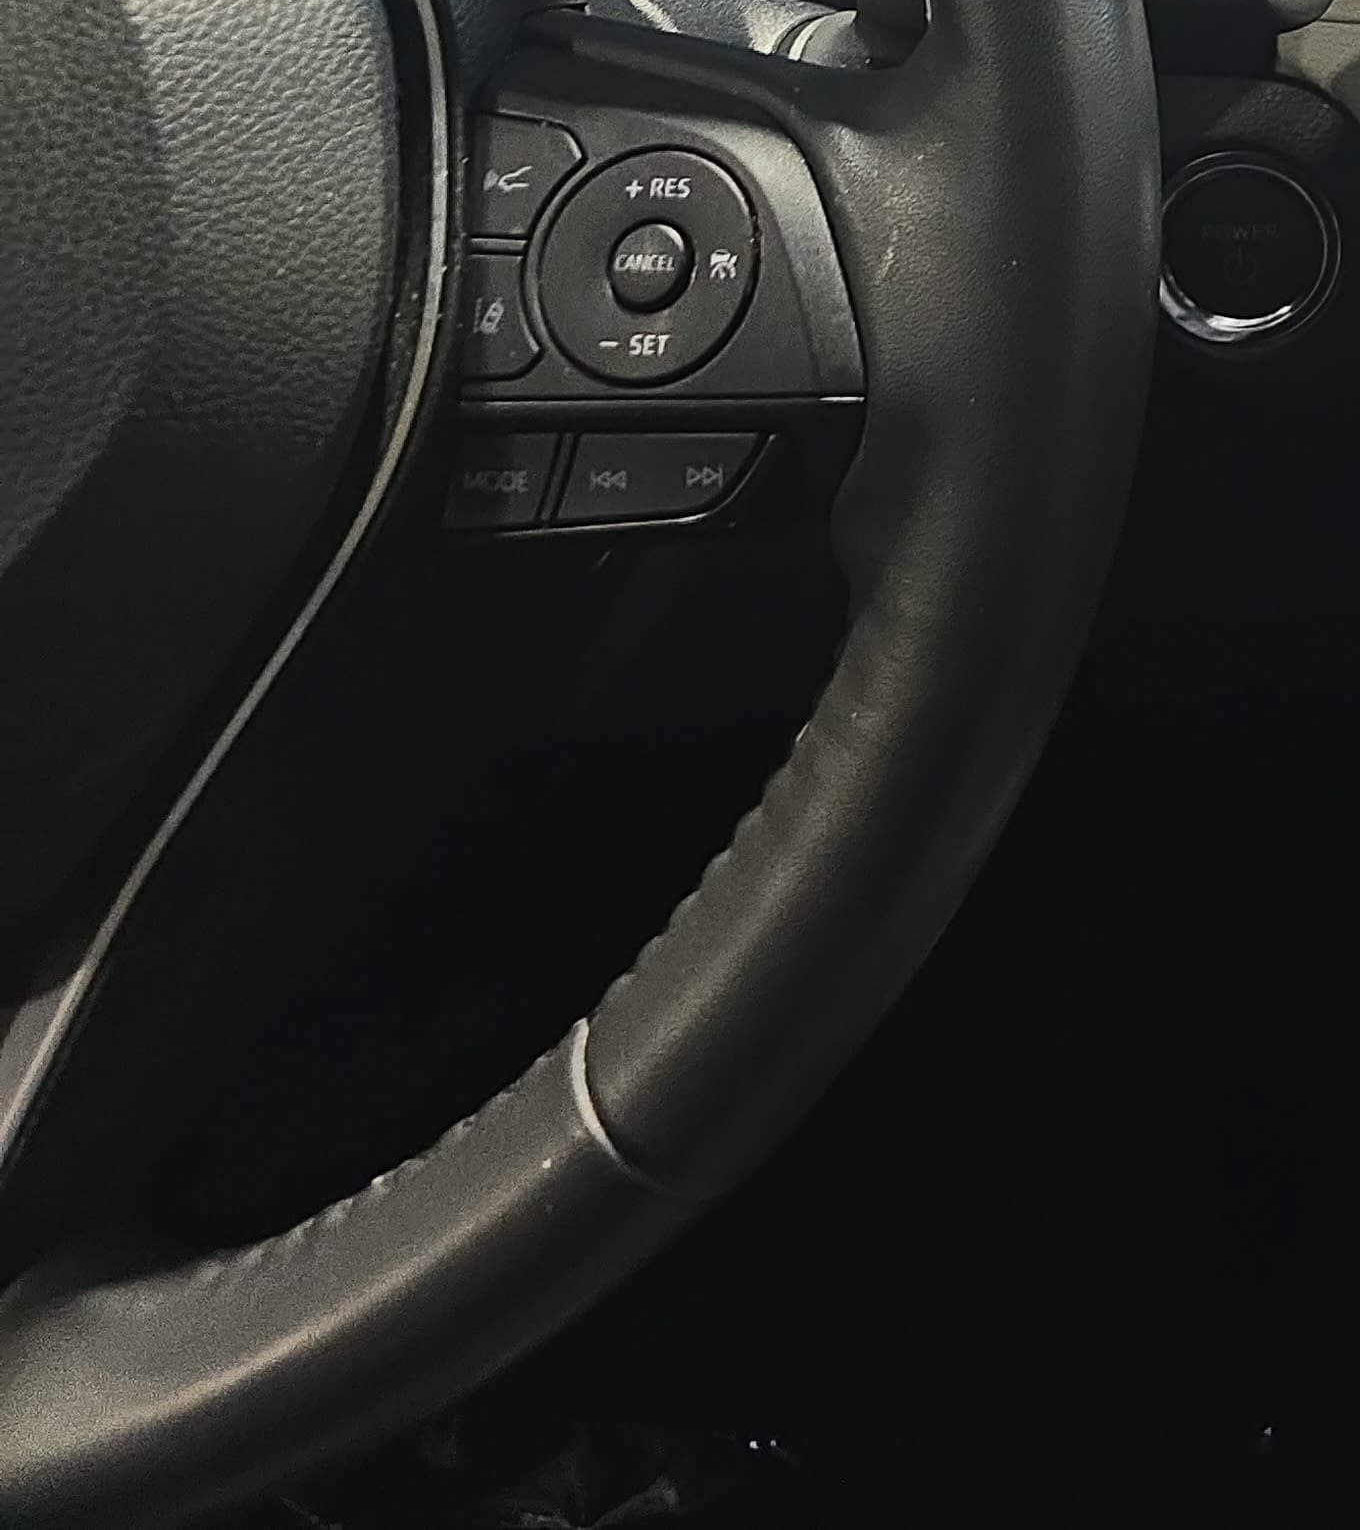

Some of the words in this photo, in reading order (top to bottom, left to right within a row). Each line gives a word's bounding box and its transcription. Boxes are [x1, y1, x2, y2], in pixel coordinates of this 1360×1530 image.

[649, 177, 691, 199] RES
[614, 252, 677, 273] CANCEL
[628, 334, 673, 357] SET
[463, 470, 529, 496] MODE
